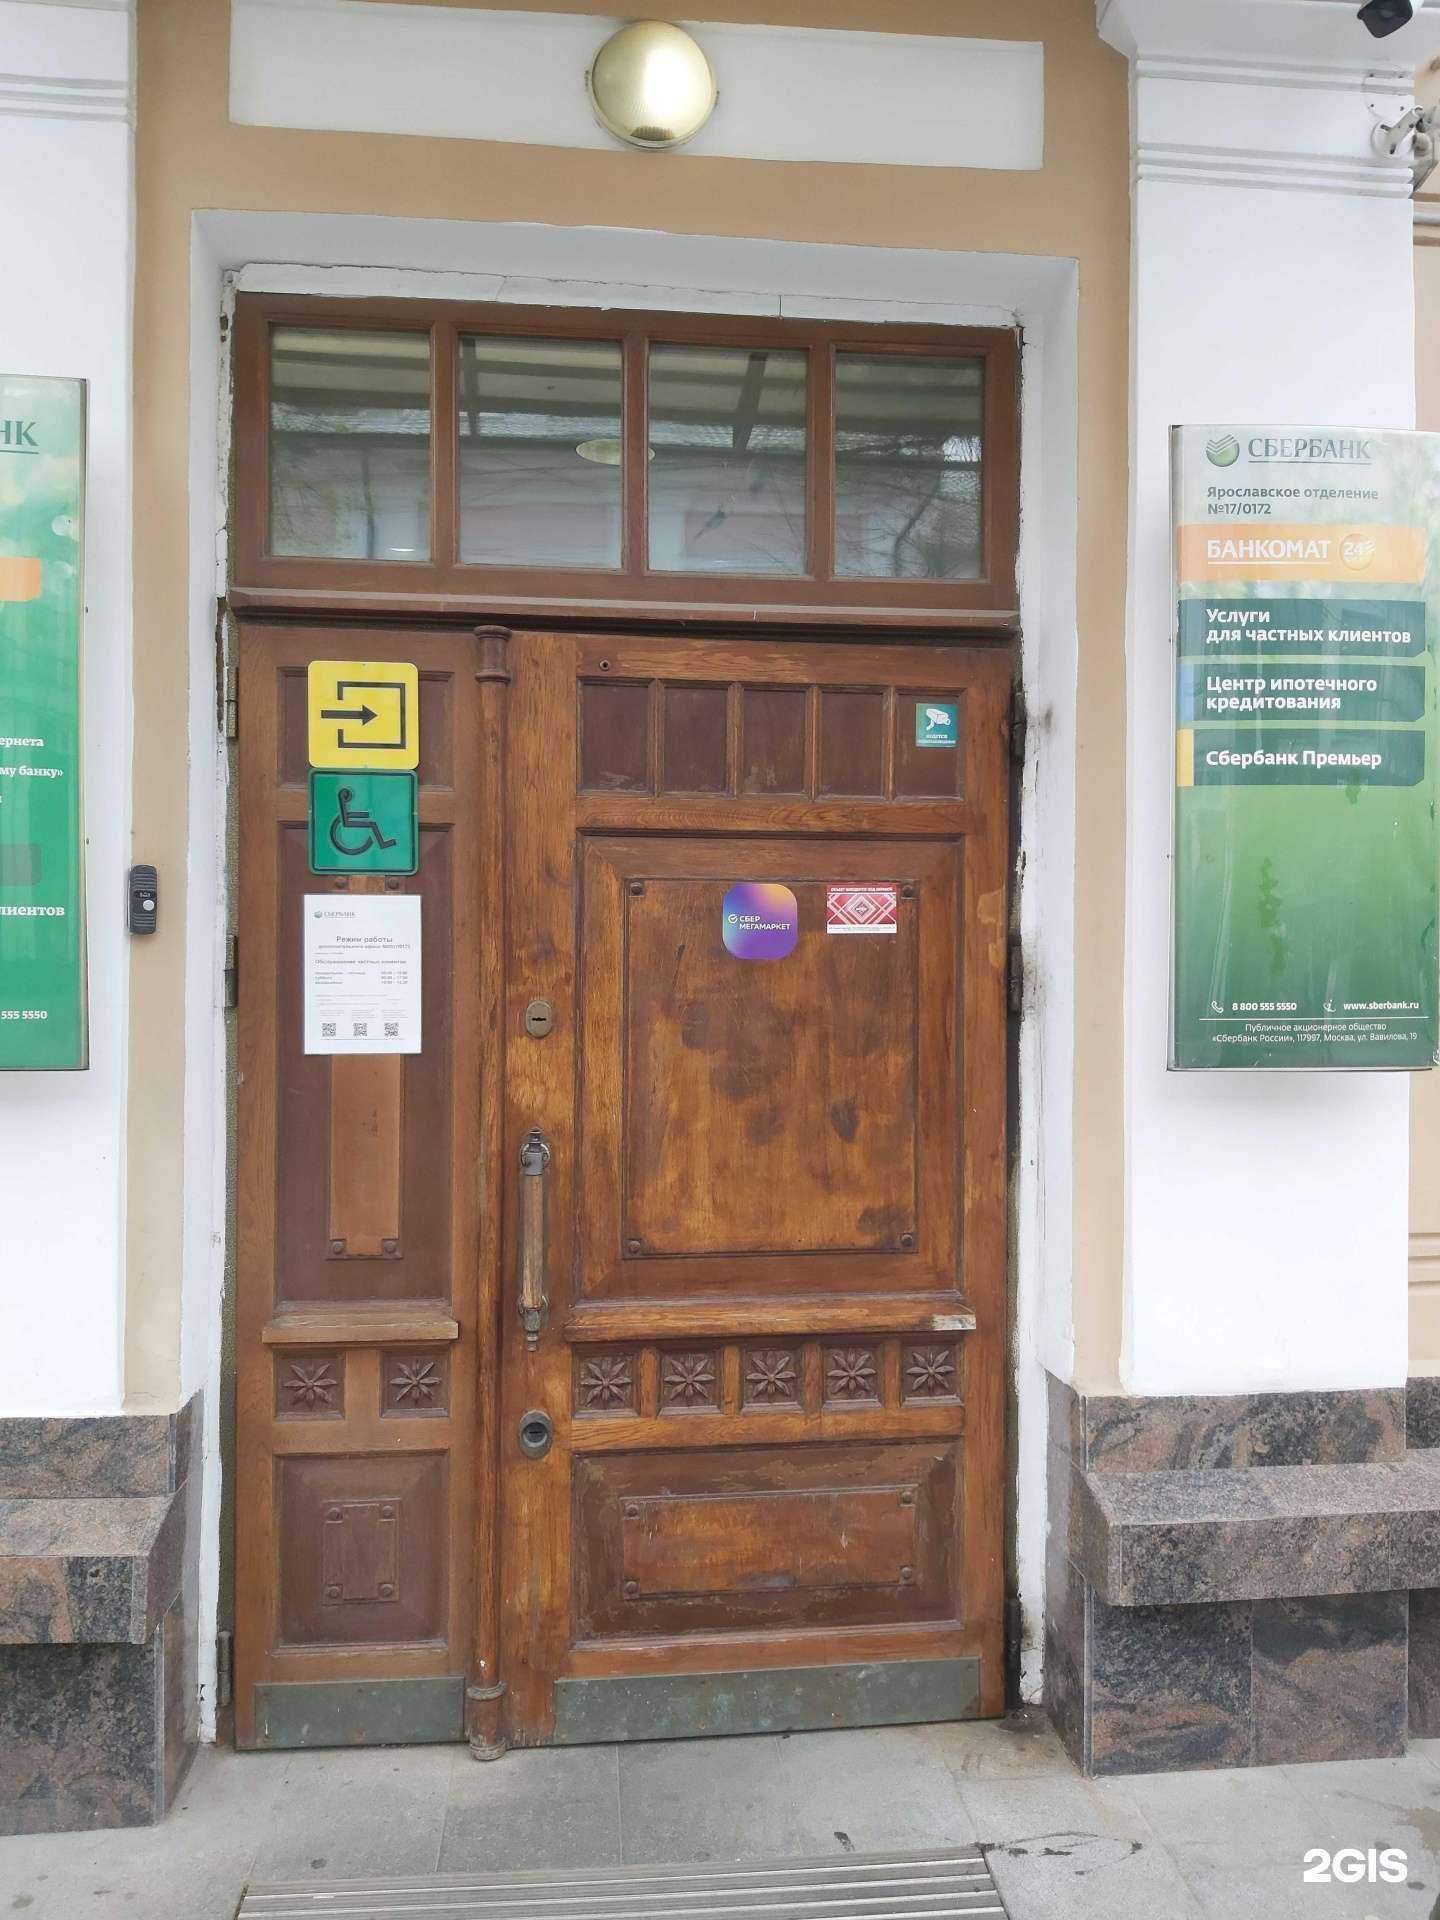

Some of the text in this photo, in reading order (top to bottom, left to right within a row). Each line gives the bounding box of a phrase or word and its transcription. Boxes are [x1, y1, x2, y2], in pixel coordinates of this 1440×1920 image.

[1248, 438, 1372, 459] СБЕРБАНК
[1207, 486, 1378, 500] Ярославское отделение
[1207, 503, 1271, 515] №17/0172
[1207, 540, 1331, 559] БАНКОМАТ
[1206, 608, 1270, 626] Услуги
[1206, 629, 1411, 644] для частных клиентов
[1206, 677, 1378, 694] Центр ипотечного
[1206, 697, 1341, 712] кредитования
[1206, 750, 1382, 769] Сбербанк Премьер
[19, 765, 64, 778] банку»
[739, 915, 761, 923] СБЕР
[739, 923, 791, 931] МЕГАМАРКЕТ
[1240, 1003, 1258, 1011] 800
[1259, 1003, 1275, 1011] 555
[1277, 1002, 1297, 1011] 5550
[1343, 1001, 1420, 1010] www.sberbank.ru
[1, 1010, 48, 1020] 555 5550
[1245, 1022, 1387, 1032] Публичное акционерное общество
